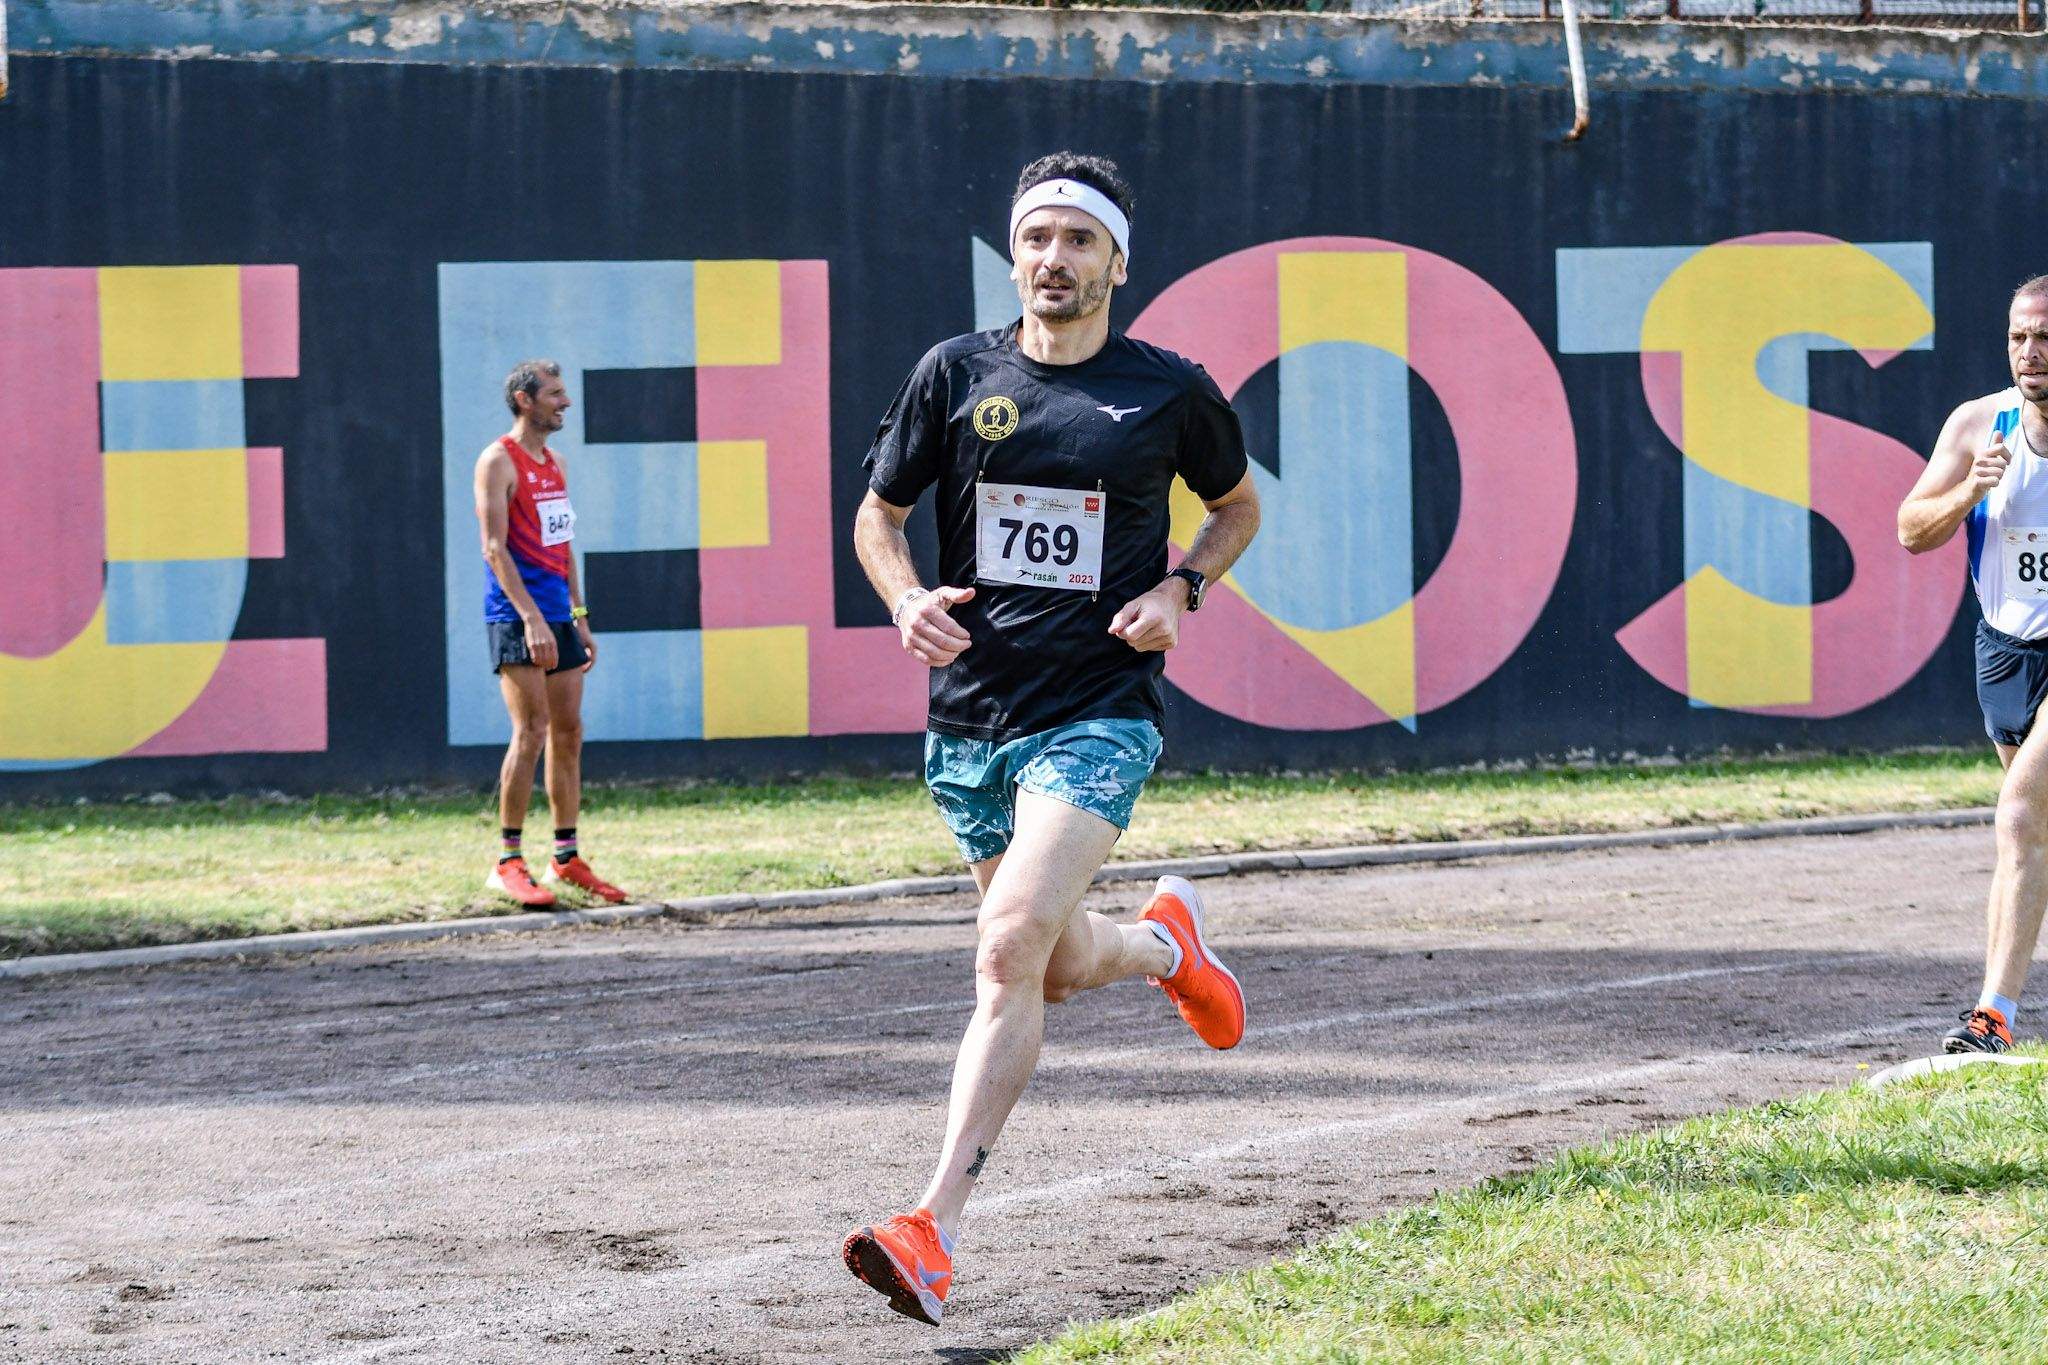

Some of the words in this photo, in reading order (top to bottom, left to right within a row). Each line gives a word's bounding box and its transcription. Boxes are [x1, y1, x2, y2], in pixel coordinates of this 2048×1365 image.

[549, 514, 570, 534] 847
[999, 518, 1079, 566] 769
[1033, 572, 1058, 583] rasán
[1068, 573, 1094, 584] 2023
